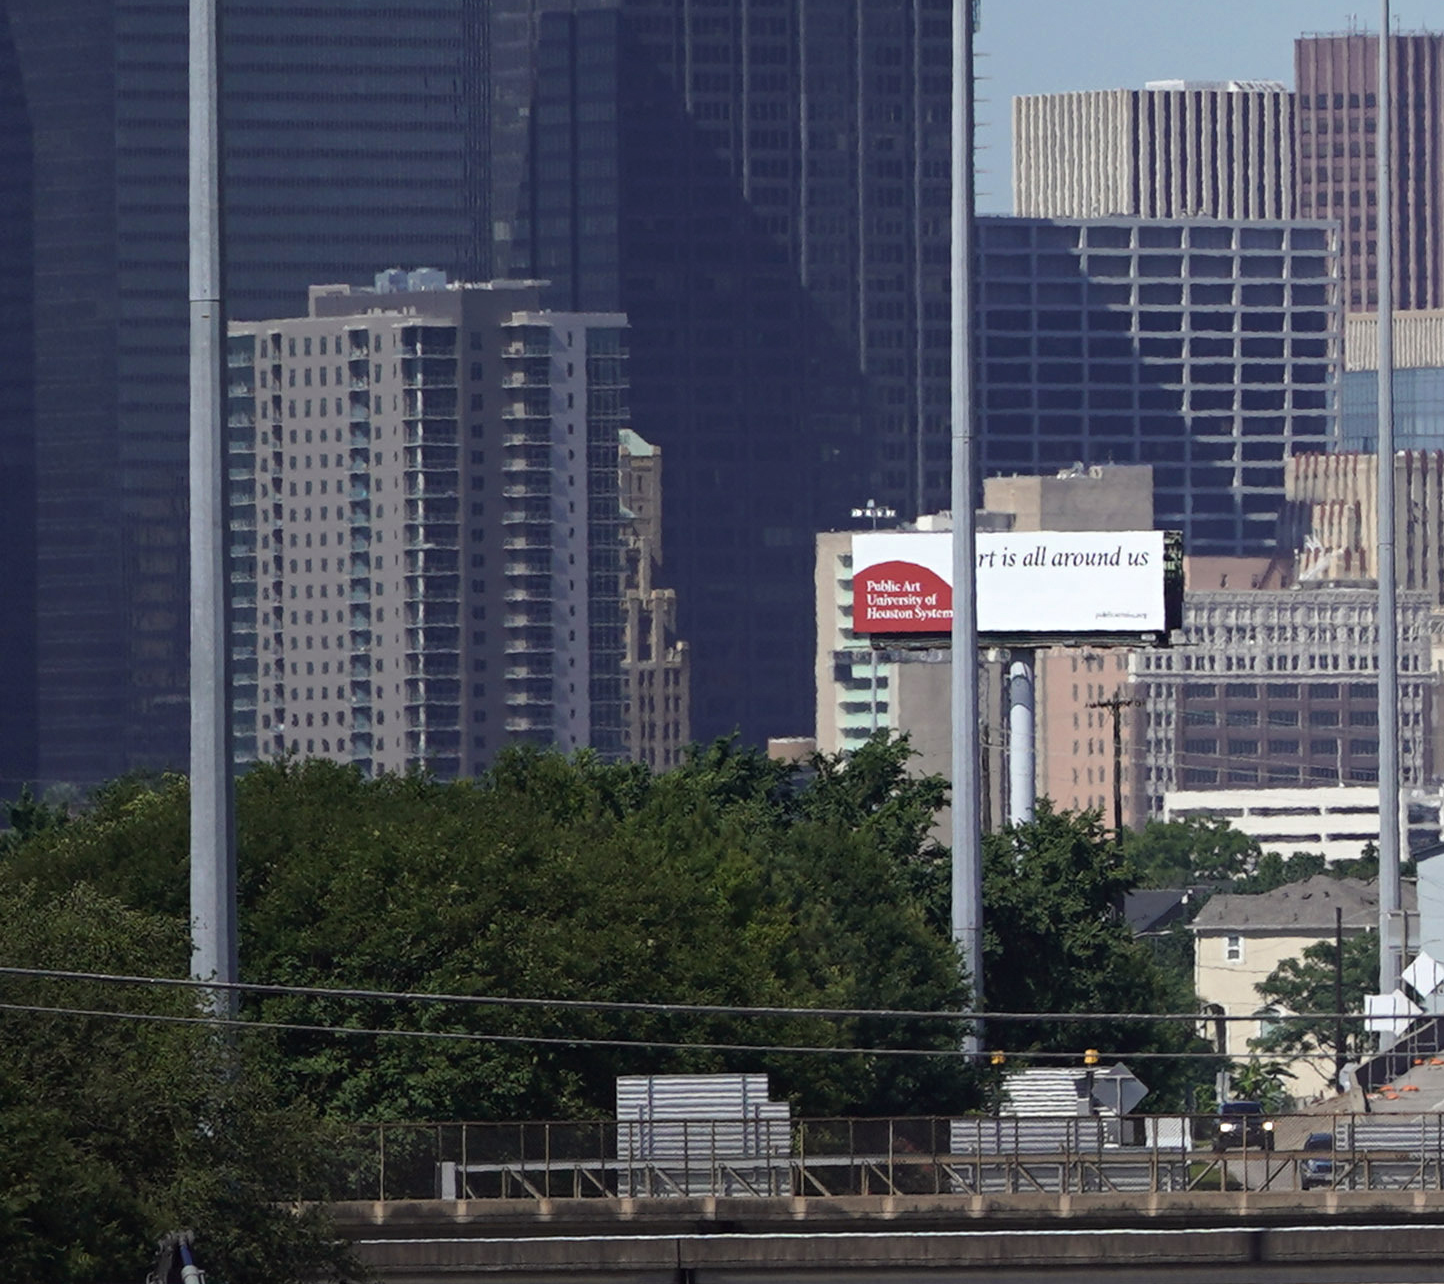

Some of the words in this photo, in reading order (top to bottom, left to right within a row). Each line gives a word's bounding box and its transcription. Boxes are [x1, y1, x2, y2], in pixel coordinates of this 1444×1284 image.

[978, 551, 997, 567] rt
[1002, 547, 1016, 567] is
[1023, 546, 1047, 567] all
[1051, 546, 1122, 567] around
[1128, 550, 1150, 567] us
[866, 580, 900, 593] Public
[902, 581, 921, 592] Art
[866, 594, 923, 607] University
[924, 593, 938, 605] of
[866, 607, 914, 620] Houston
[914, 606, 953, 621] System
